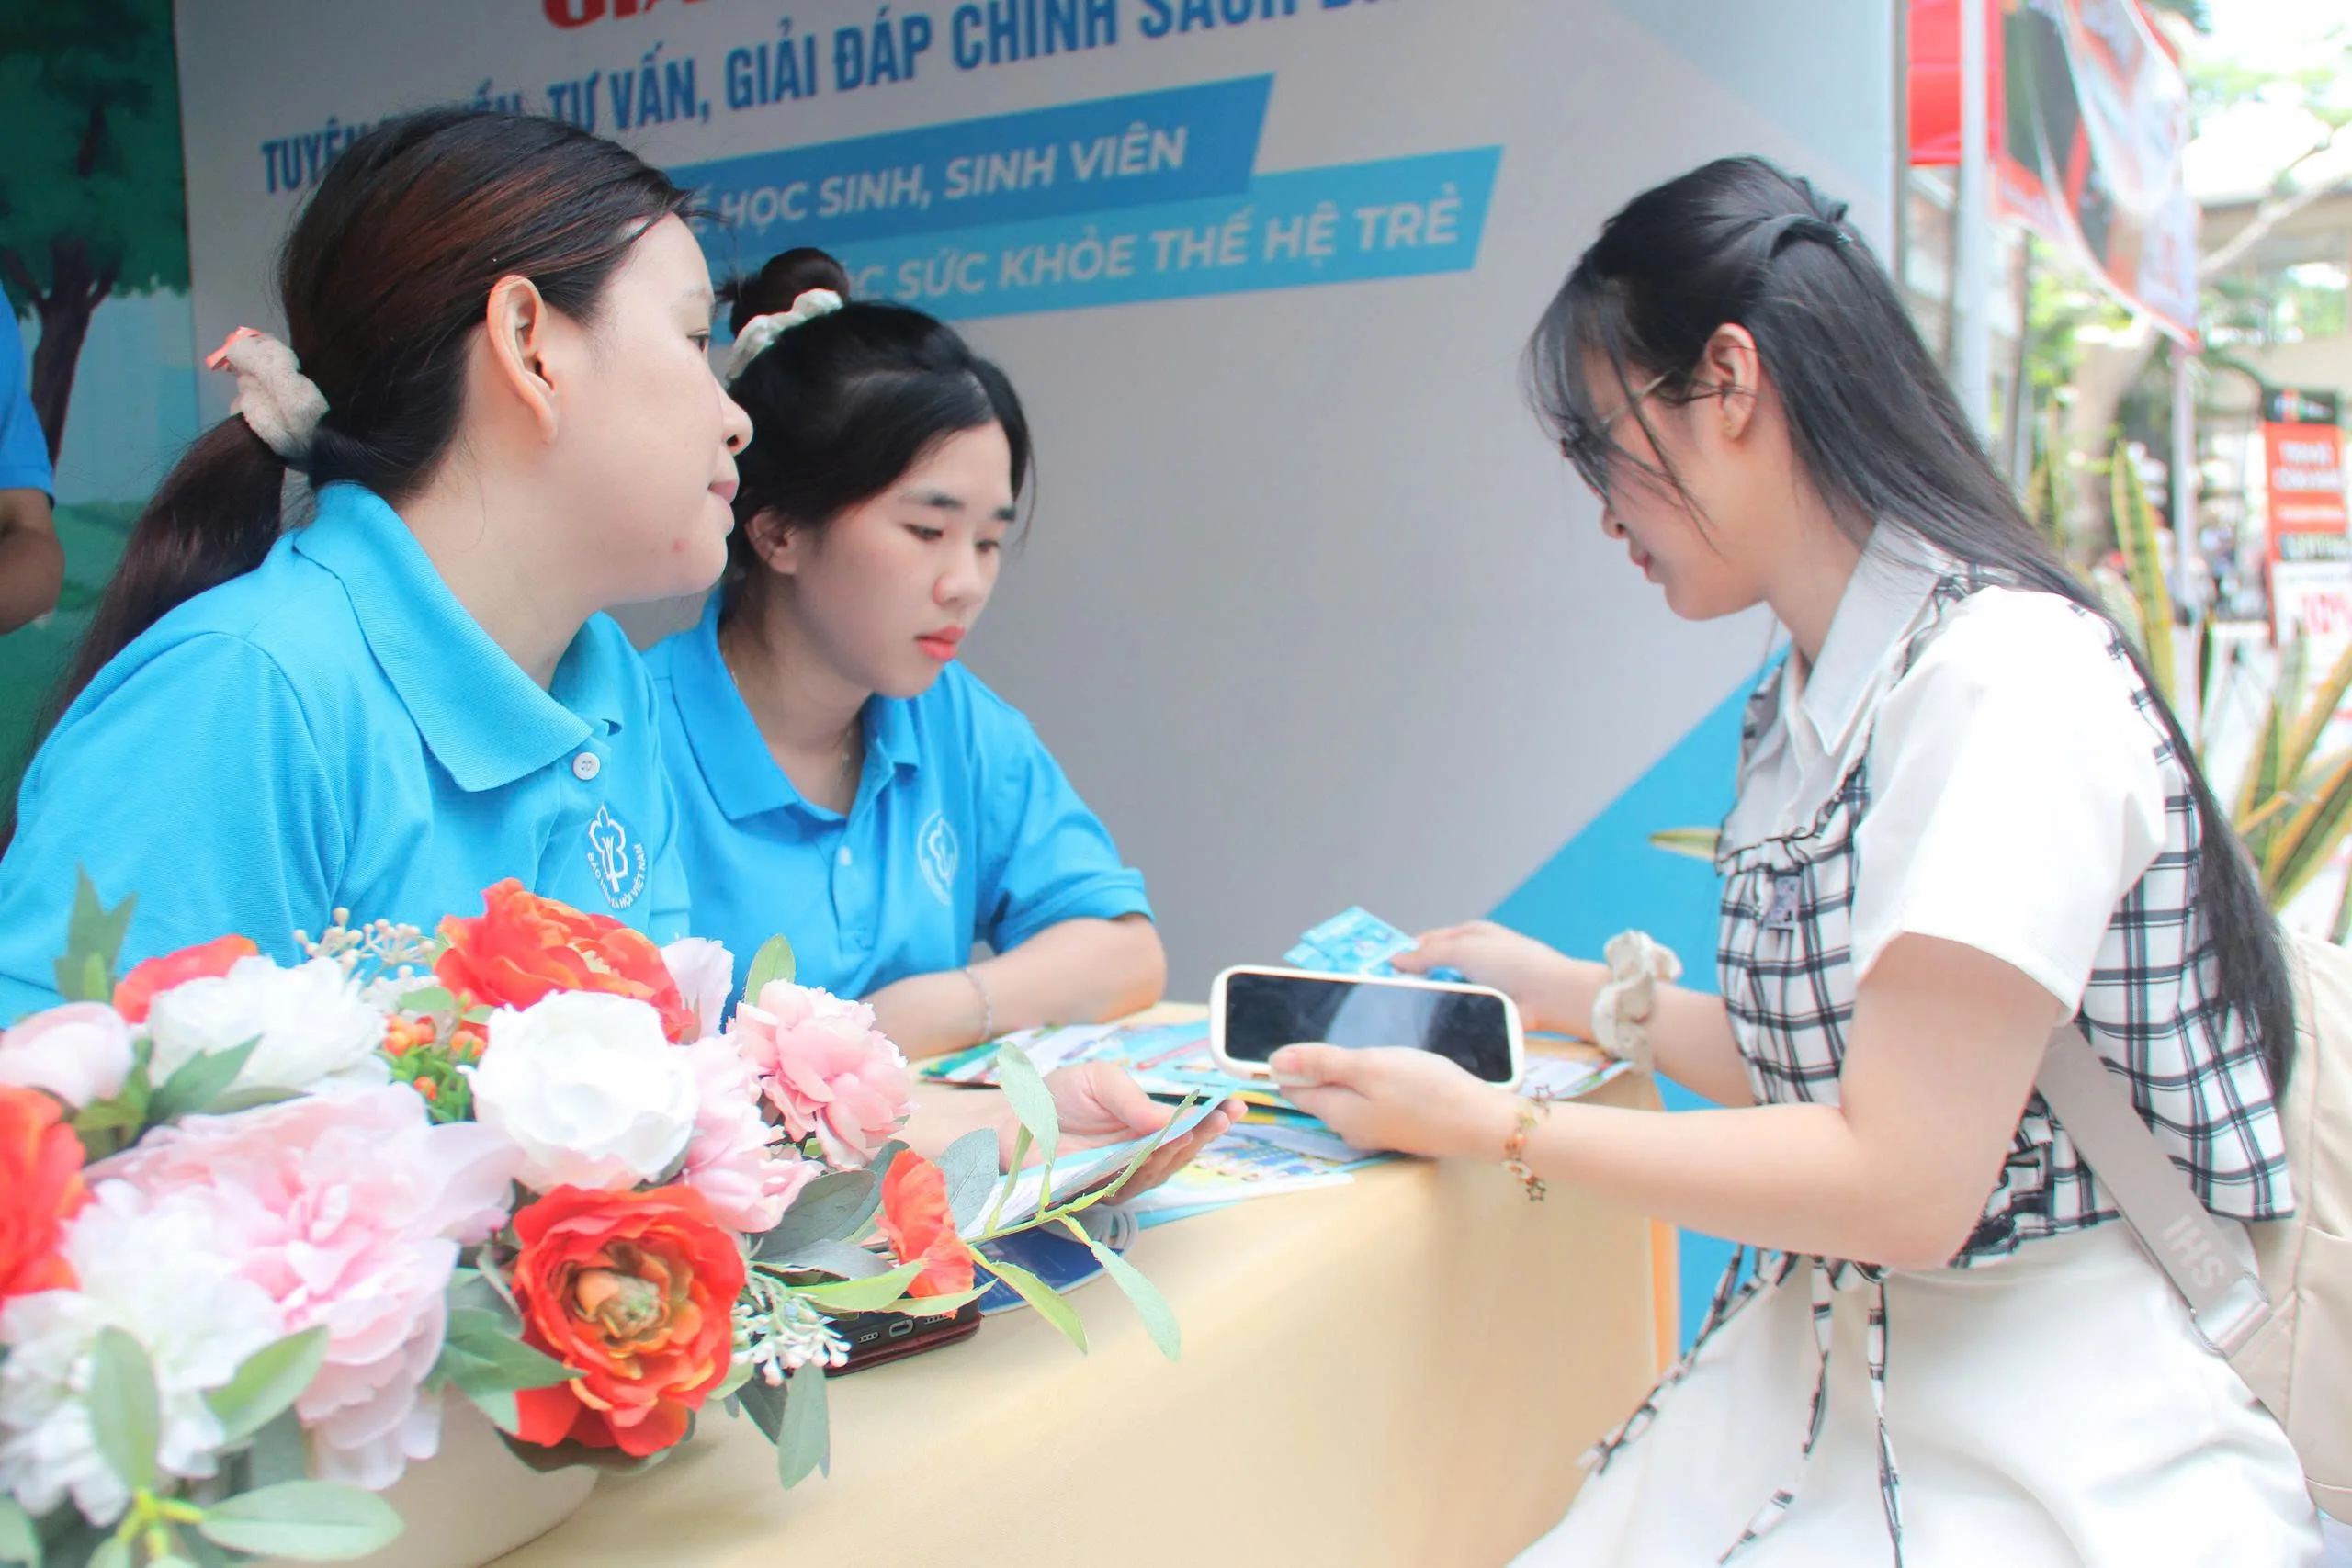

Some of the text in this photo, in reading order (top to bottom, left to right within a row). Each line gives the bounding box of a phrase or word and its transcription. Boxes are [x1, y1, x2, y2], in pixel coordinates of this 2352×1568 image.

[609, 40, 711, 130] VẤN,
[725, 15, 818, 111] GIẢI
[832, 4, 933, 93] ĐÁP
[719, 180, 808, 236] HỌC
[817, 163, 932, 218] SINH,
[943, 142, 1057, 200] SINH
[1069, 121, 1188, 183] VIÊN
[895, 244, 988, 302] SỨC
[998, 224, 1137, 291] KHỎE
[1150, 204, 1256, 273] THẾ
[1262, 199, 1340, 269] HỆ
[1352, 182, 1463, 253] TRẺ
